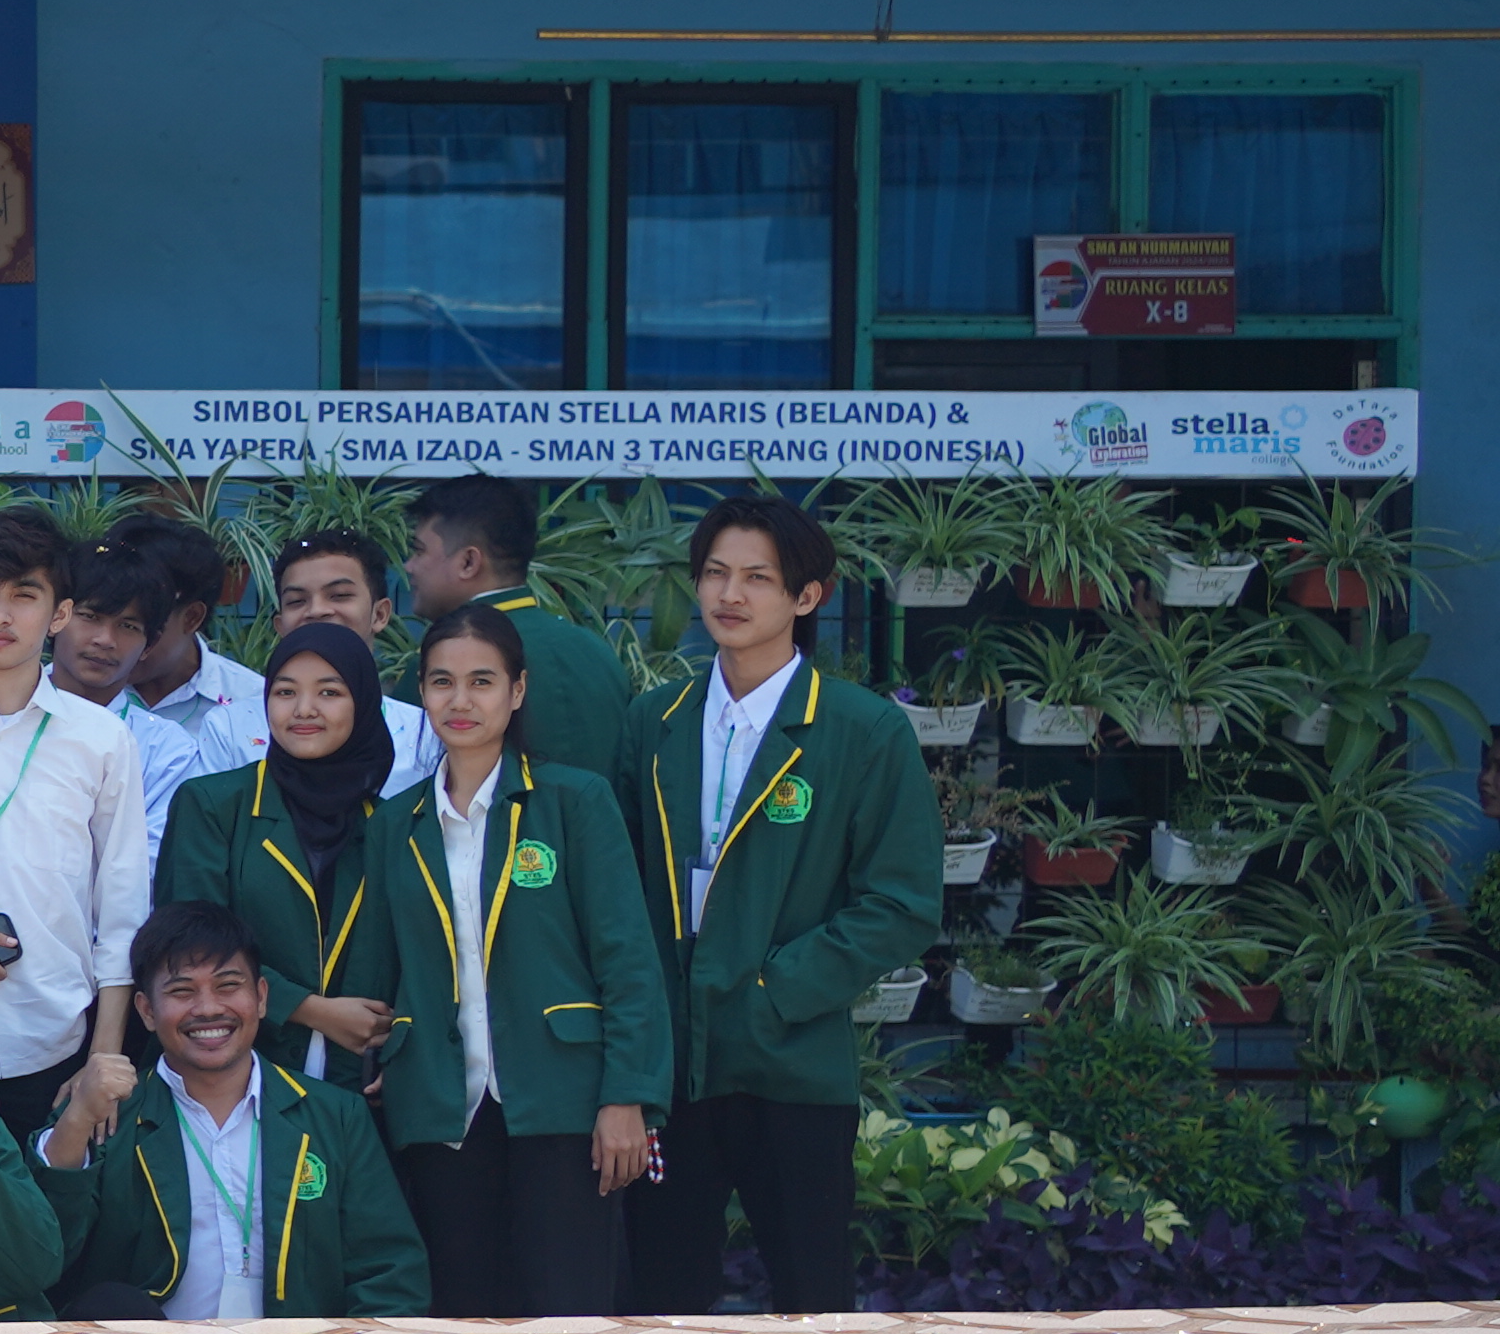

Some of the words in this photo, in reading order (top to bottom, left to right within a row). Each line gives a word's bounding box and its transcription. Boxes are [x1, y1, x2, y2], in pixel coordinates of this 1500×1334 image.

[1087, 240, 1116, 255] SMA
[1141, 240, 1229, 255] NURMANIYAH
[1105, 279, 1168, 295] RUANG
[1175, 279, 1229, 295] KELAS
[1145, 300, 1188, 323] X-8
[192, 399, 310, 424] SIMBOL
[318, 400, 550, 424] PERSAHABATAN
[558, 401, 663, 424] STELLA
[670, 401, 767, 424] MARIS
[776, 401, 937, 429] (BELANDA)
[946, 401, 970, 425] &
[1171, 412, 1270, 435] stella
[1088, 421, 1147, 447] Global
[1192, 430, 1301, 454] maris
[202, 437, 316, 462] YAPERA
[342, 438, 408, 462] SMA
[416, 438, 504, 462] IZADA
[528, 439, 615, 462] SMAN
[623, 439, 641, 462] 3
[649, 439, 829, 462] TANGERANG
[837, 439, 1026, 466] (INDONESIA)
